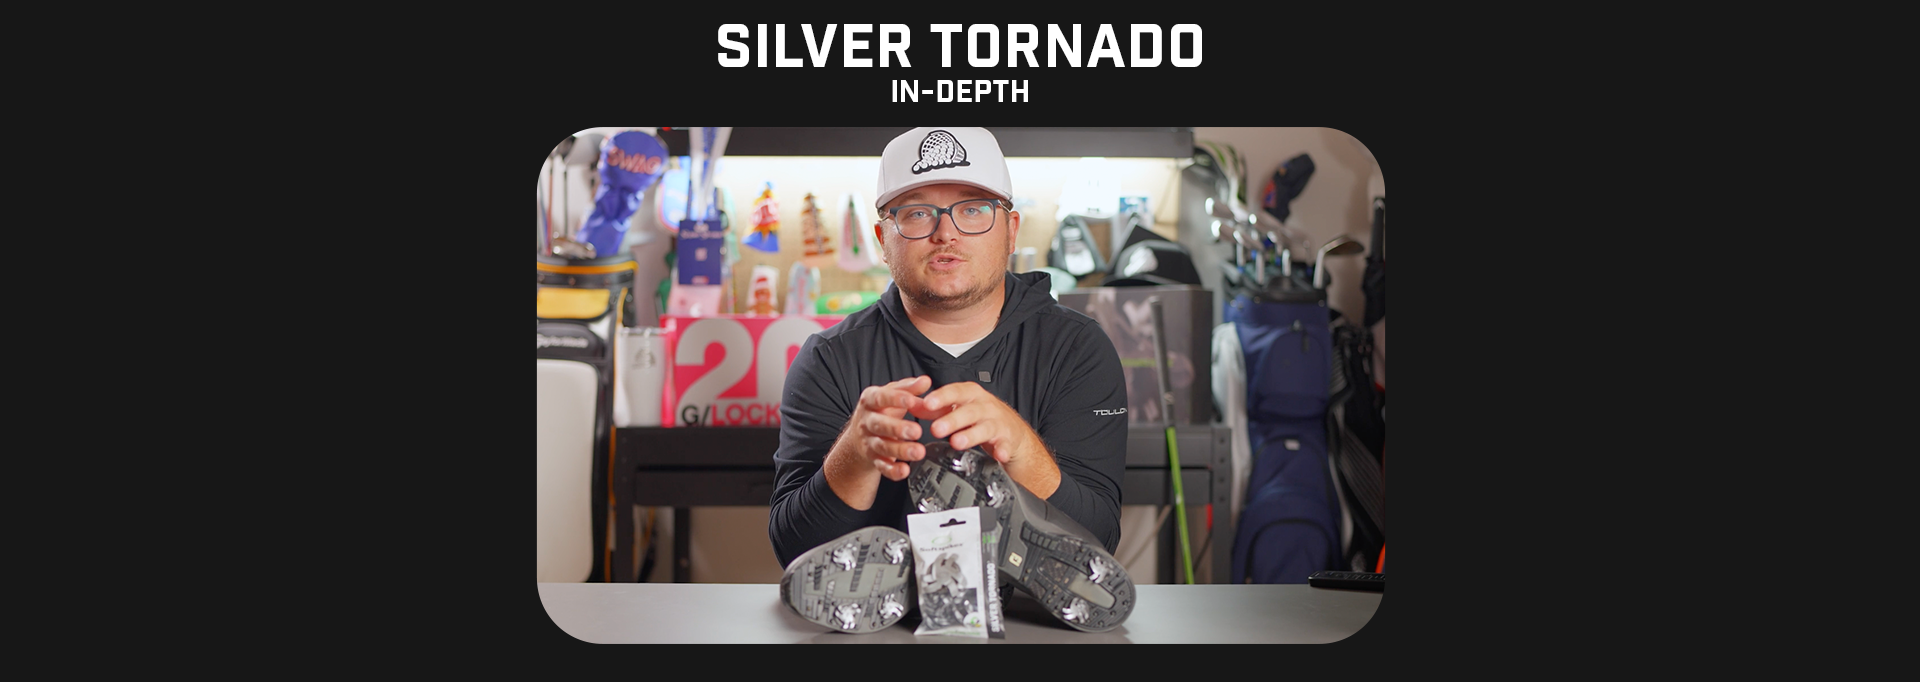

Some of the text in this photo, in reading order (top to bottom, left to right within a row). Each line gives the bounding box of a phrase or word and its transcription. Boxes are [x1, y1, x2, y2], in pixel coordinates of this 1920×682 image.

[607, 148, 663, 175] SWAG
[986, 562, 998, 602] TORNADO
[989, 602, 1001, 633] SILVER
